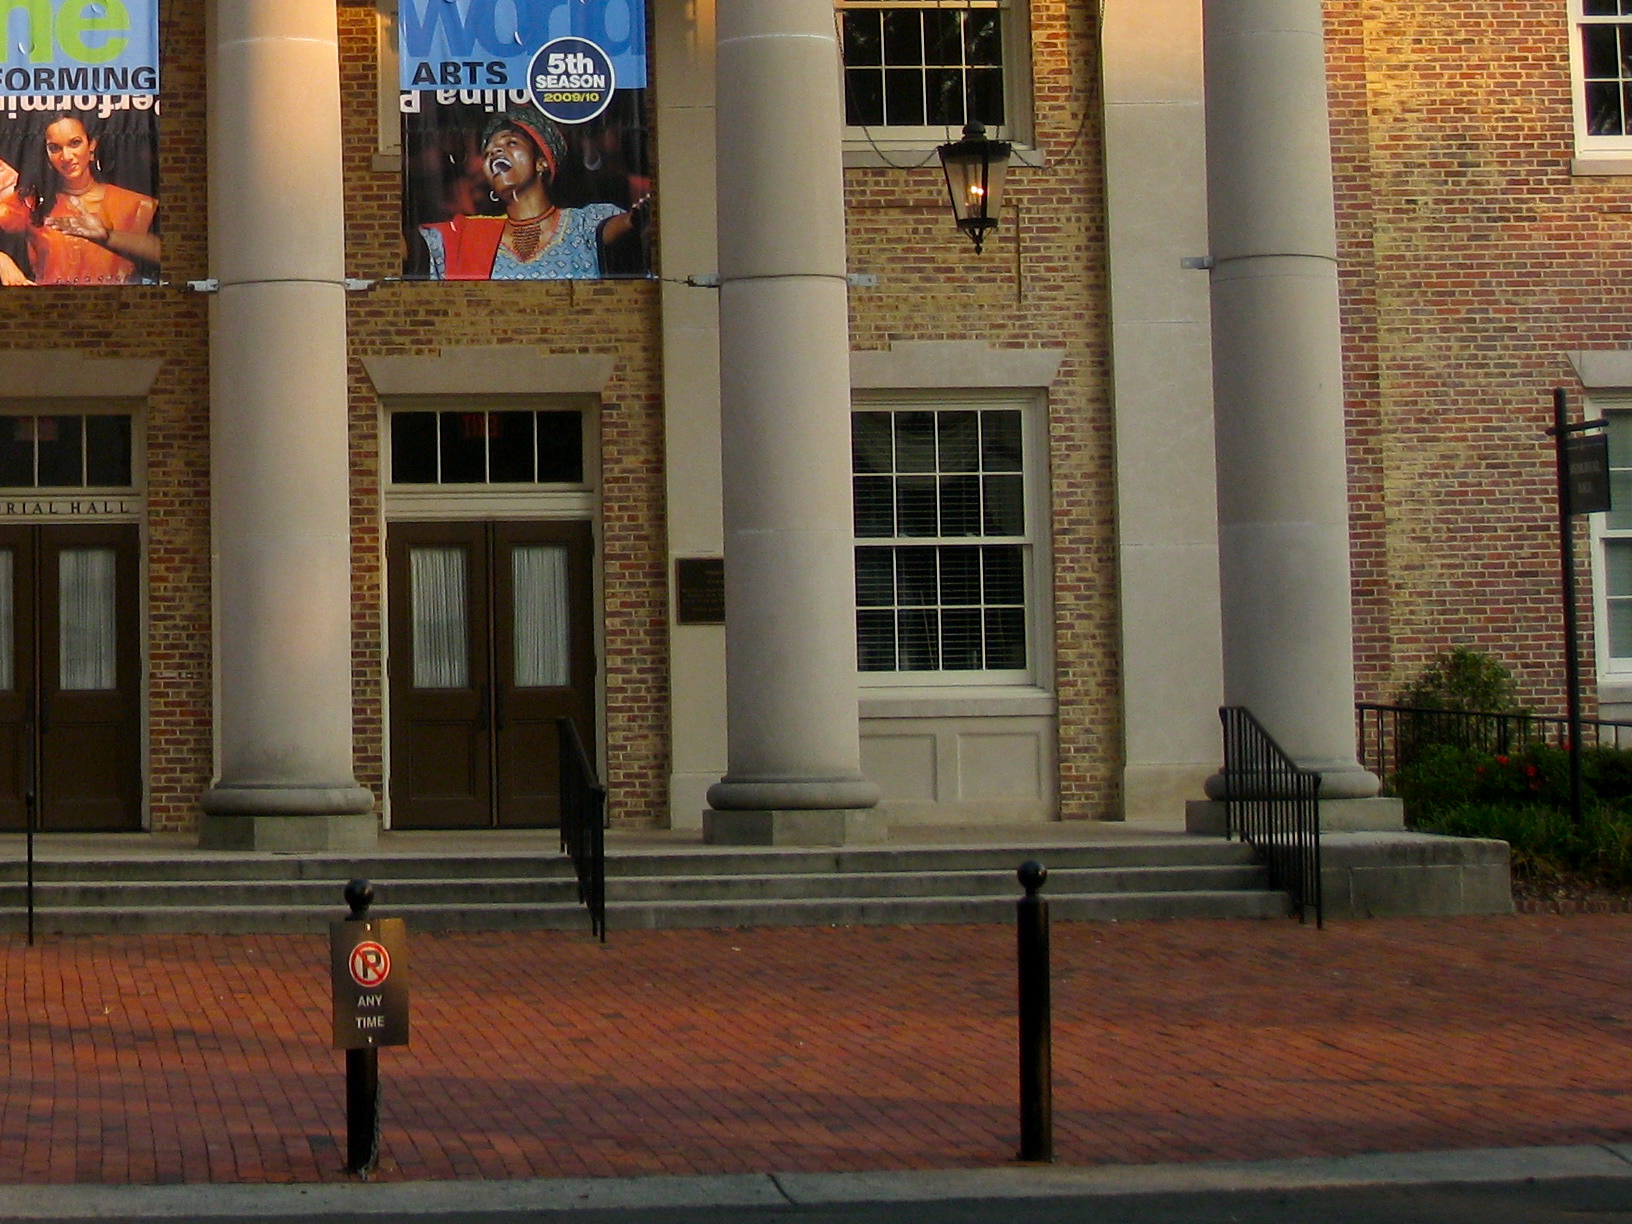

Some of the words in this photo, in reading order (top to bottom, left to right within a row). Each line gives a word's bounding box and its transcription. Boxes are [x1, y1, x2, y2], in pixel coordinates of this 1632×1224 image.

[547, 52, 594, 74] 5th
[412, 61, 508, 85] ARTS
[535, 74, 606, 89] SEASON
[543, 93, 600, 103] 2009/10
[71, 501, 130, 514] HALL
[357, 995, 383, 1007] ANY
[355, 1016, 385, 1028] TIME
